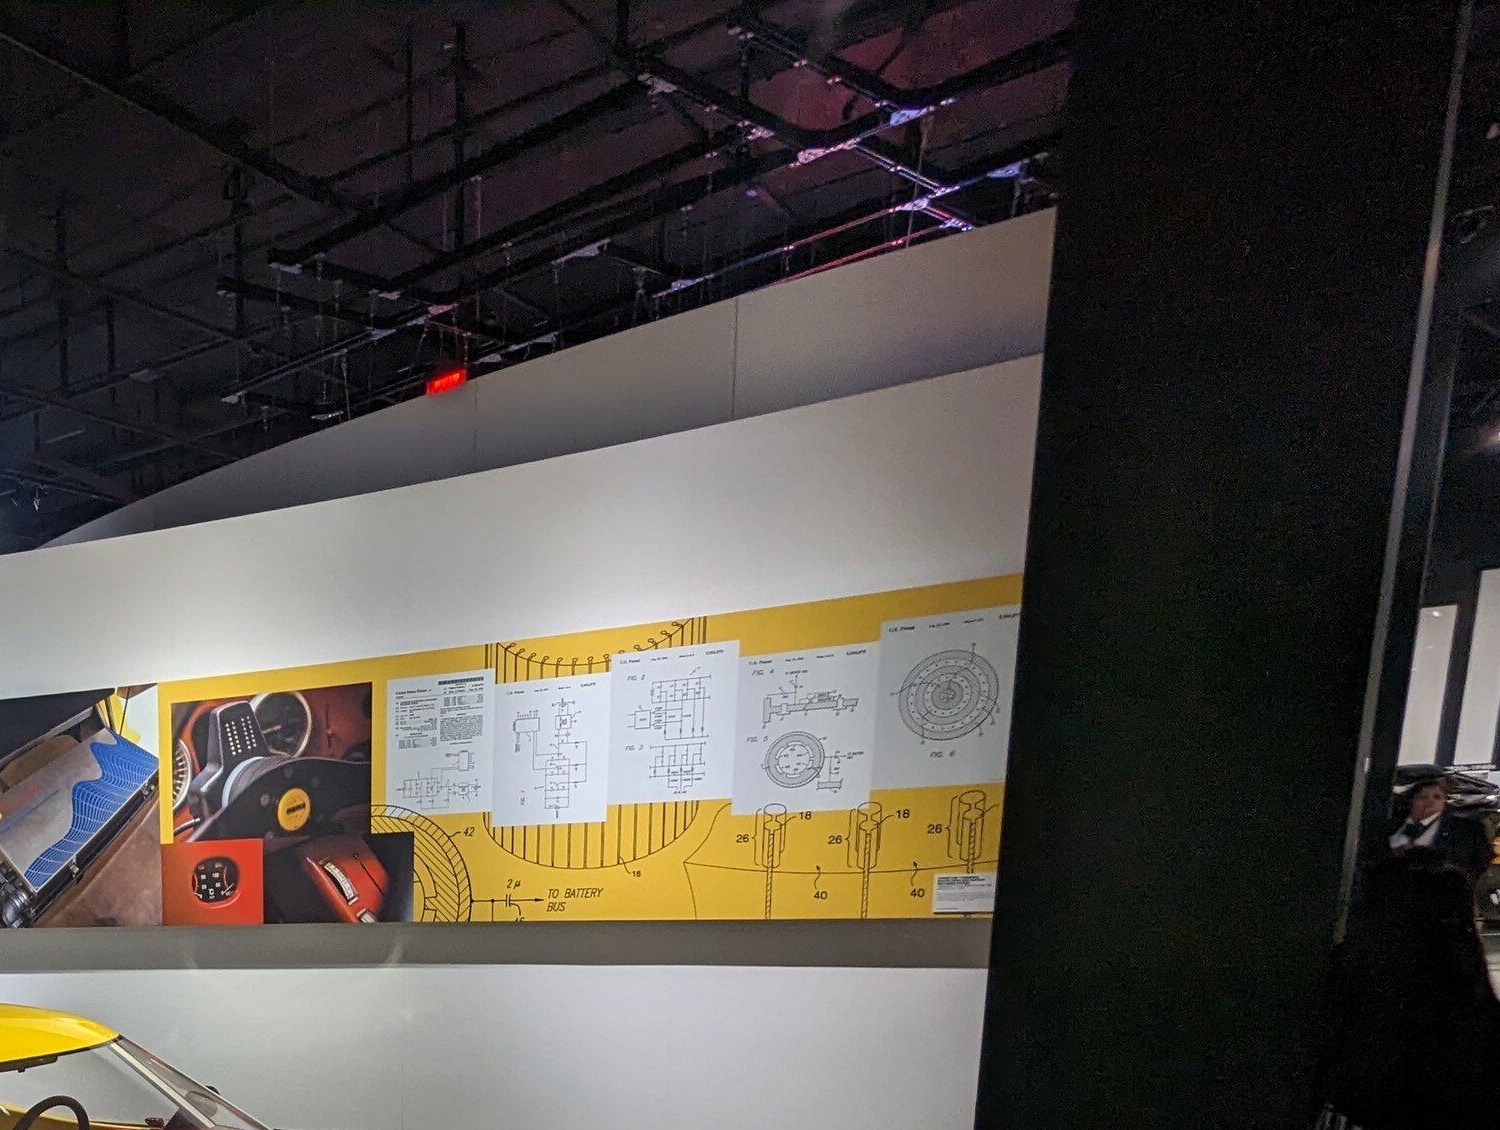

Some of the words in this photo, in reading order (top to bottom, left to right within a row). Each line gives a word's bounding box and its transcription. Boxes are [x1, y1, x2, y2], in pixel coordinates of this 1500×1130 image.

[798, 810, 812, 820] 18
[896, 809, 910, 819] 18
[463, 826, 475, 837] 42
[927, 823, 943, 834] 26
[736, 833, 750, 843] 26
[828, 834, 843, 845] 26
[506, 878, 513, 888] 2
[547, 888, 560, 899] TO
[564, 887, 604, 899] BATTERY
[813, 890, 828, 900] 40
[909, 887, 925, 898] 40
[546, 901, 566, 912] BUS
